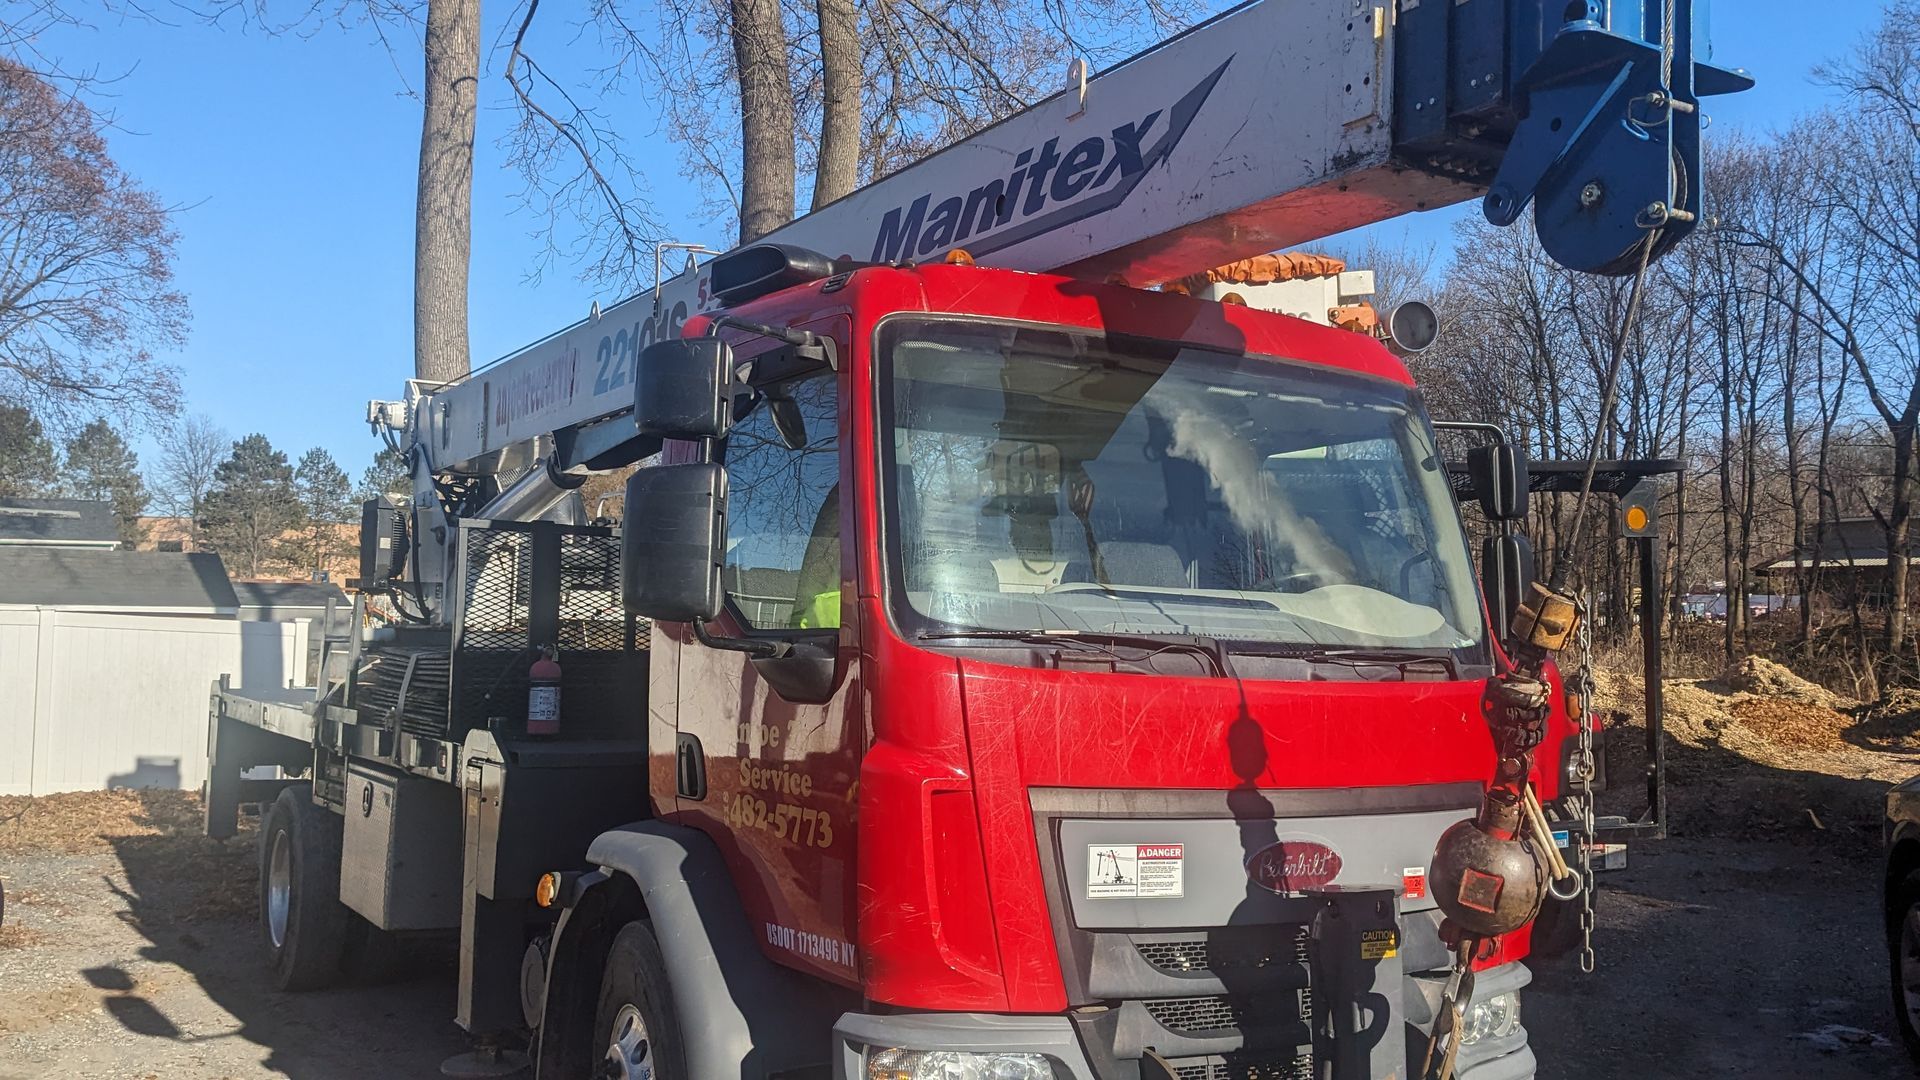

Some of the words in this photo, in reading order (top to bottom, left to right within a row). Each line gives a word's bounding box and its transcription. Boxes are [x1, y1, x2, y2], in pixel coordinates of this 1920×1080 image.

[870, 109, 1163, 263] Manitex
[740, 757, 812, 798] Service
[730, 793, 833, 848] 482-5773
[1146, 848, 1181, 857] DANGER
[1260, 850, 1332, 880] Peterbilt
[765, 922, 795, 950] USDOT
[797, 930, 839, 963] 1713496
[841, 942, 855, 967] NY
[1362, 930, 1395, 941] CAUTION
